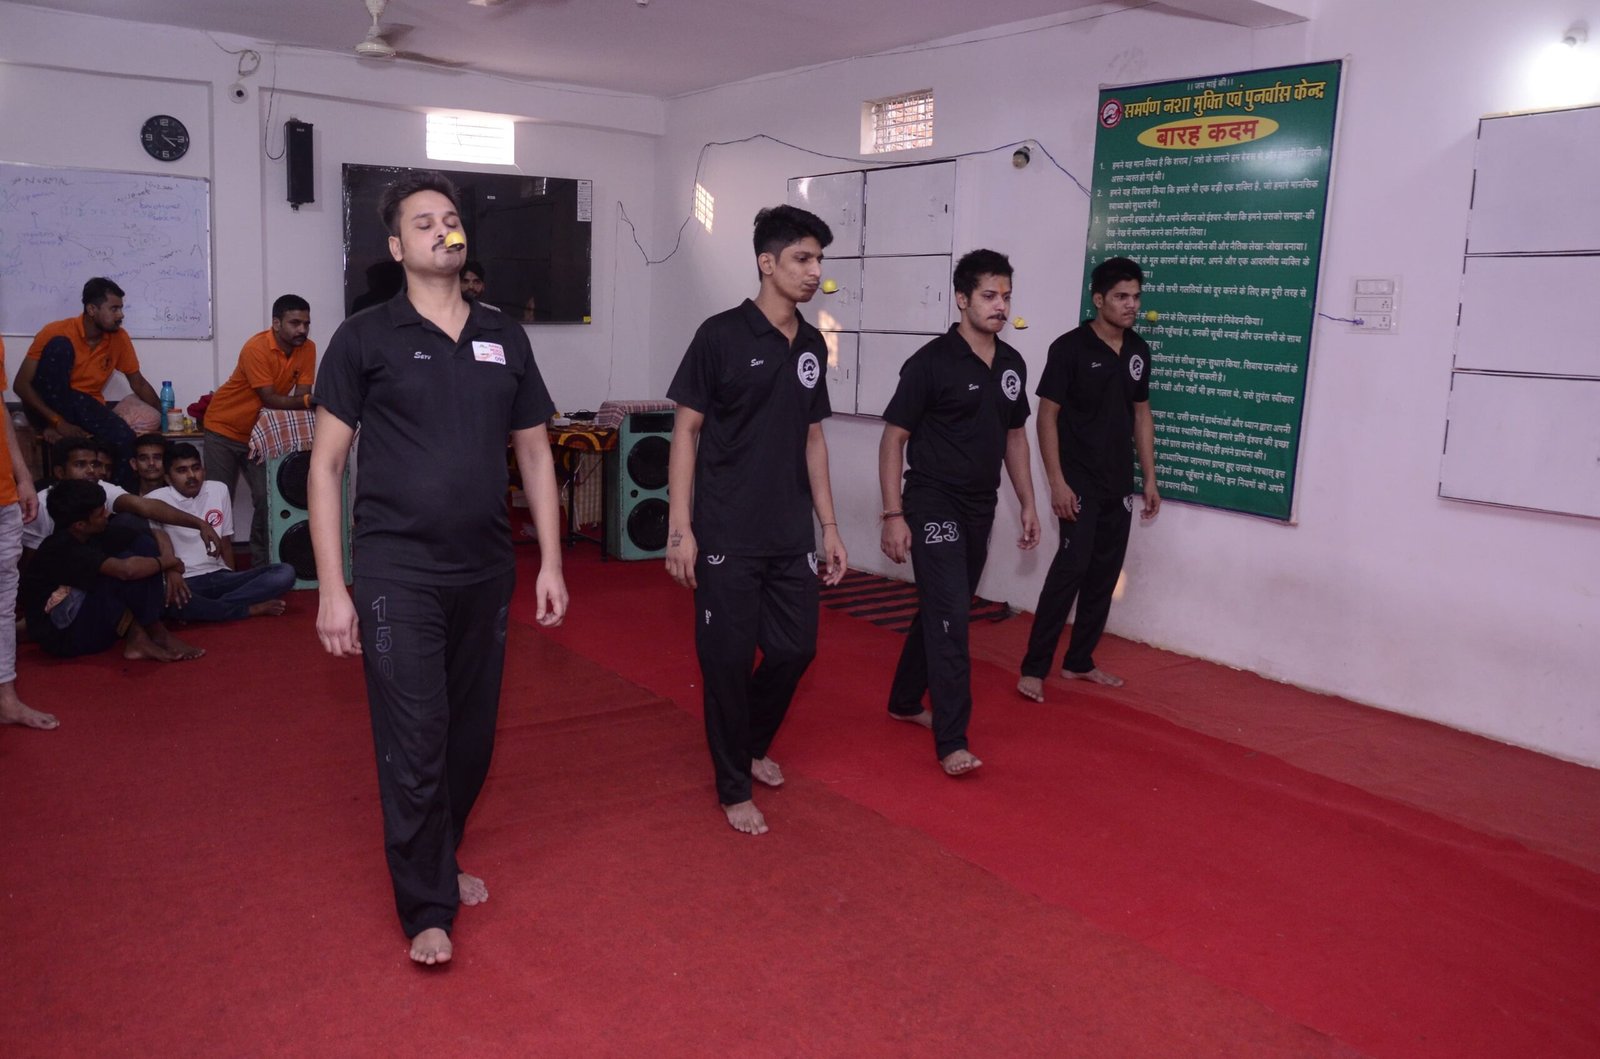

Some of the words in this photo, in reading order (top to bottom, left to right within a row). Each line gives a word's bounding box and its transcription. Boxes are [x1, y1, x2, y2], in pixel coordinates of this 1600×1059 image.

[1124, 97, 1162, 119] समर्पण
[1164, 97, 1192, 114] नशा
[1194, 90, 1225, 117] मुक्ति
[1227, 84, 1243, 108] एवं
[1244, 81, 1292, 112] पुनर्वास
[1294, 79, 1327, 101] केन्द्र
[1156, 126, 1203, 146] बारह
[1208, 120, 1260, 143] कदम
[924, 521, 960, 544] 23
